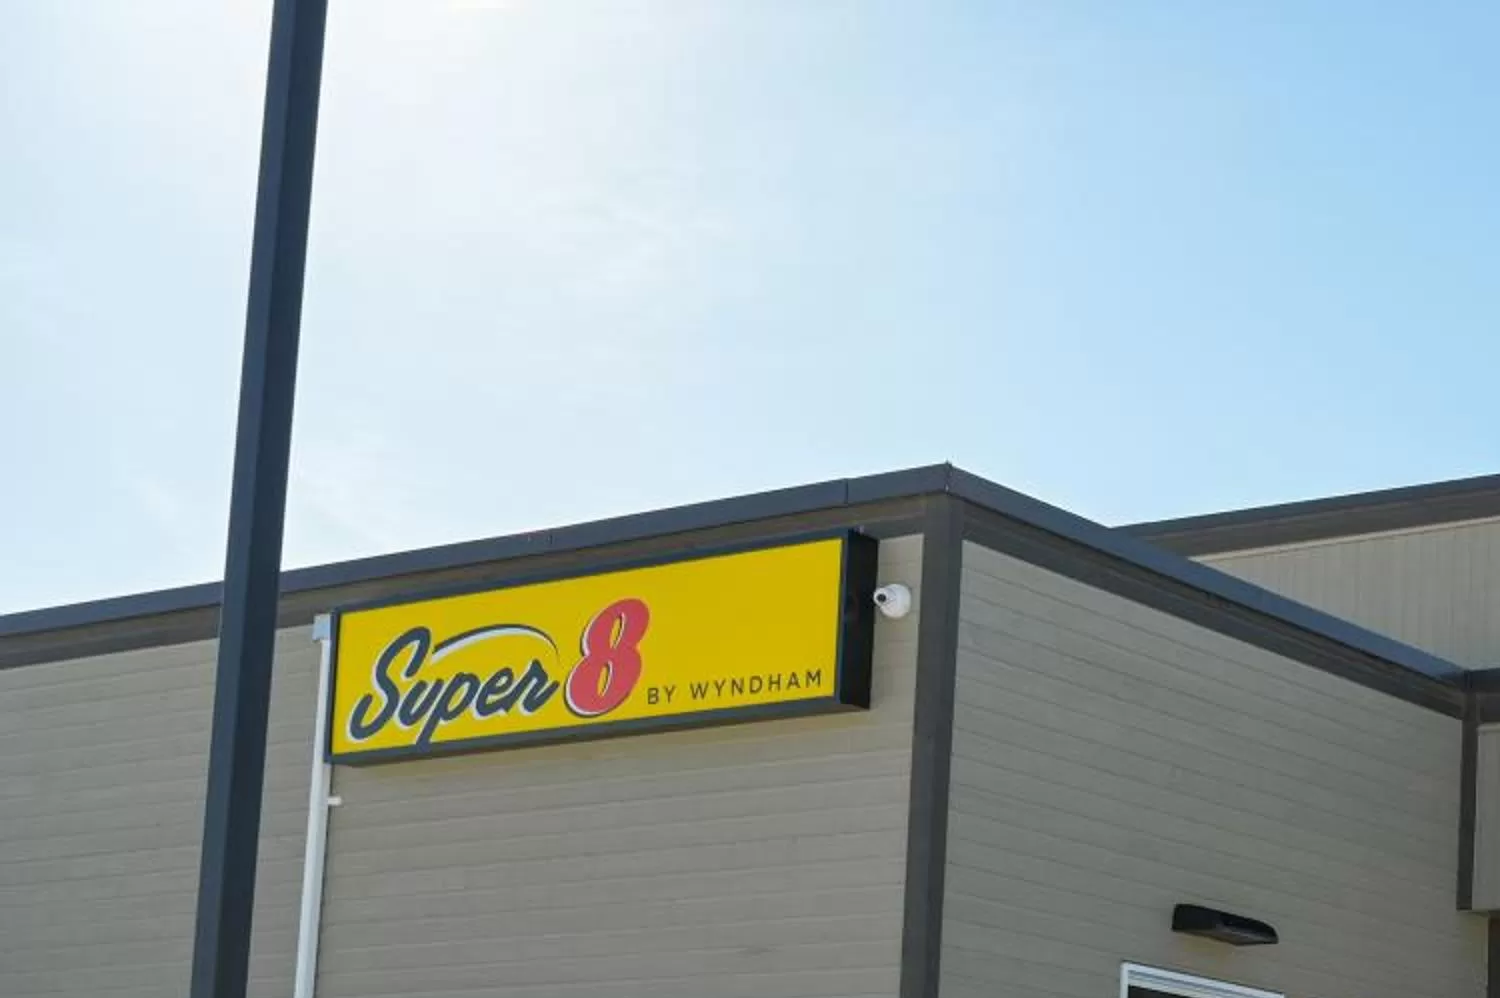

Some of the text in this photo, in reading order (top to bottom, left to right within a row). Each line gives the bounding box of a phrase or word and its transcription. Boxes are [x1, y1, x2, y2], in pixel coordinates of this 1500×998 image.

[347, 597, 650, 751] Super 8
[647, 669, 822, 705] BY WYNDHAM
